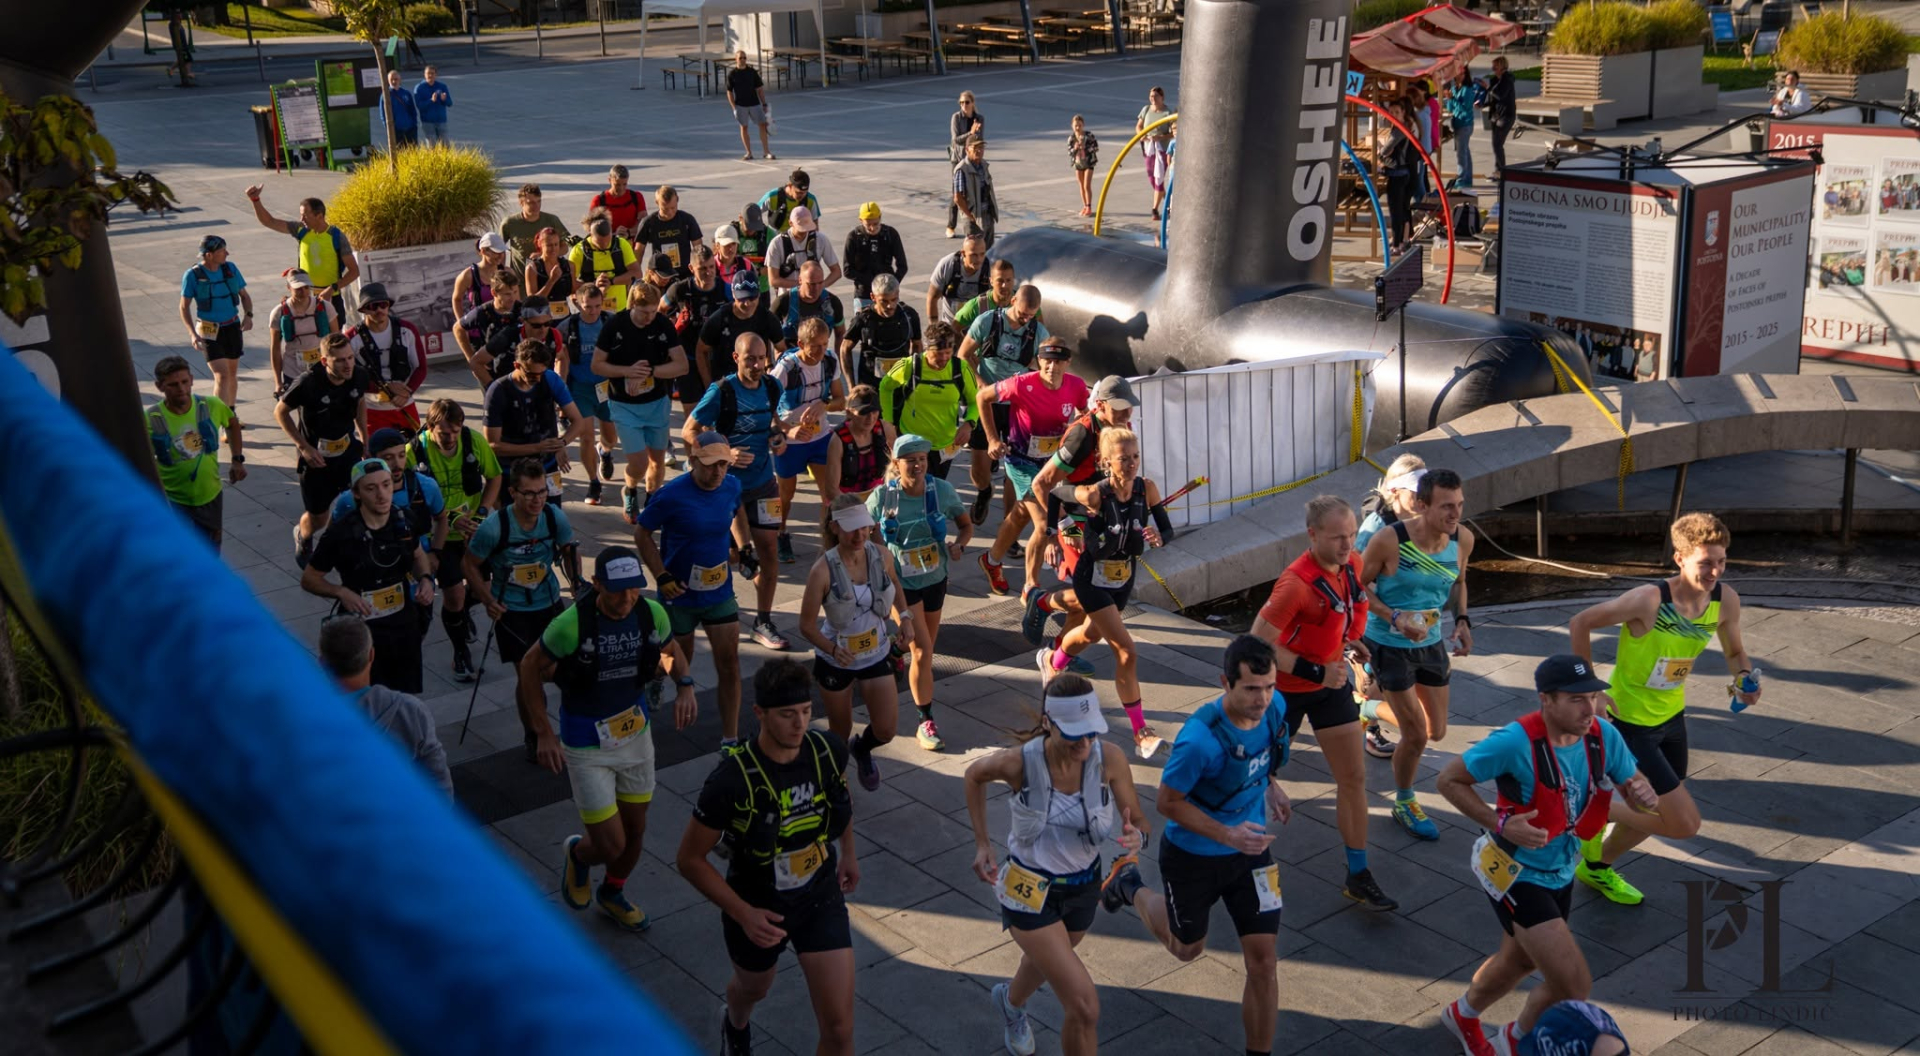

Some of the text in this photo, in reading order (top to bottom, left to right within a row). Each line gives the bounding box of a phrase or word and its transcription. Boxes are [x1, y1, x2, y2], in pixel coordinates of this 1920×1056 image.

[1287, 16, 1346, 261] OSHEE
[1774, 133, 1815, 151] 2015
[1509, 186, 1669, 219] OBČINA SMO LJUDJE
[1734, 203, 1758, 219] OUR
[1732, 210, 1808, 240] MUNICIPALITY,
[1731, 233, 1794, 259] OUR PEOPLE
[1725, 330, 1747, 349] 2015
[1756, 322, 1779, 340] 2025
[1803, 316, 1890, 347] REPIH
[527, 571, 537, 580] 31
[709, 572, 721, 582] 30
[1115, 568, 1122, 577] 4
[384, 594, 395, 605] 12
[859, 638, 870, 649] 35
[608, 650, 638, 660] 2024
[1673, 667, 1688, 677] 40
[621, 719, 635, 732] 47
[1489, 861, 1500, 875] 2
[1013, 882, 1033, 899] 43
